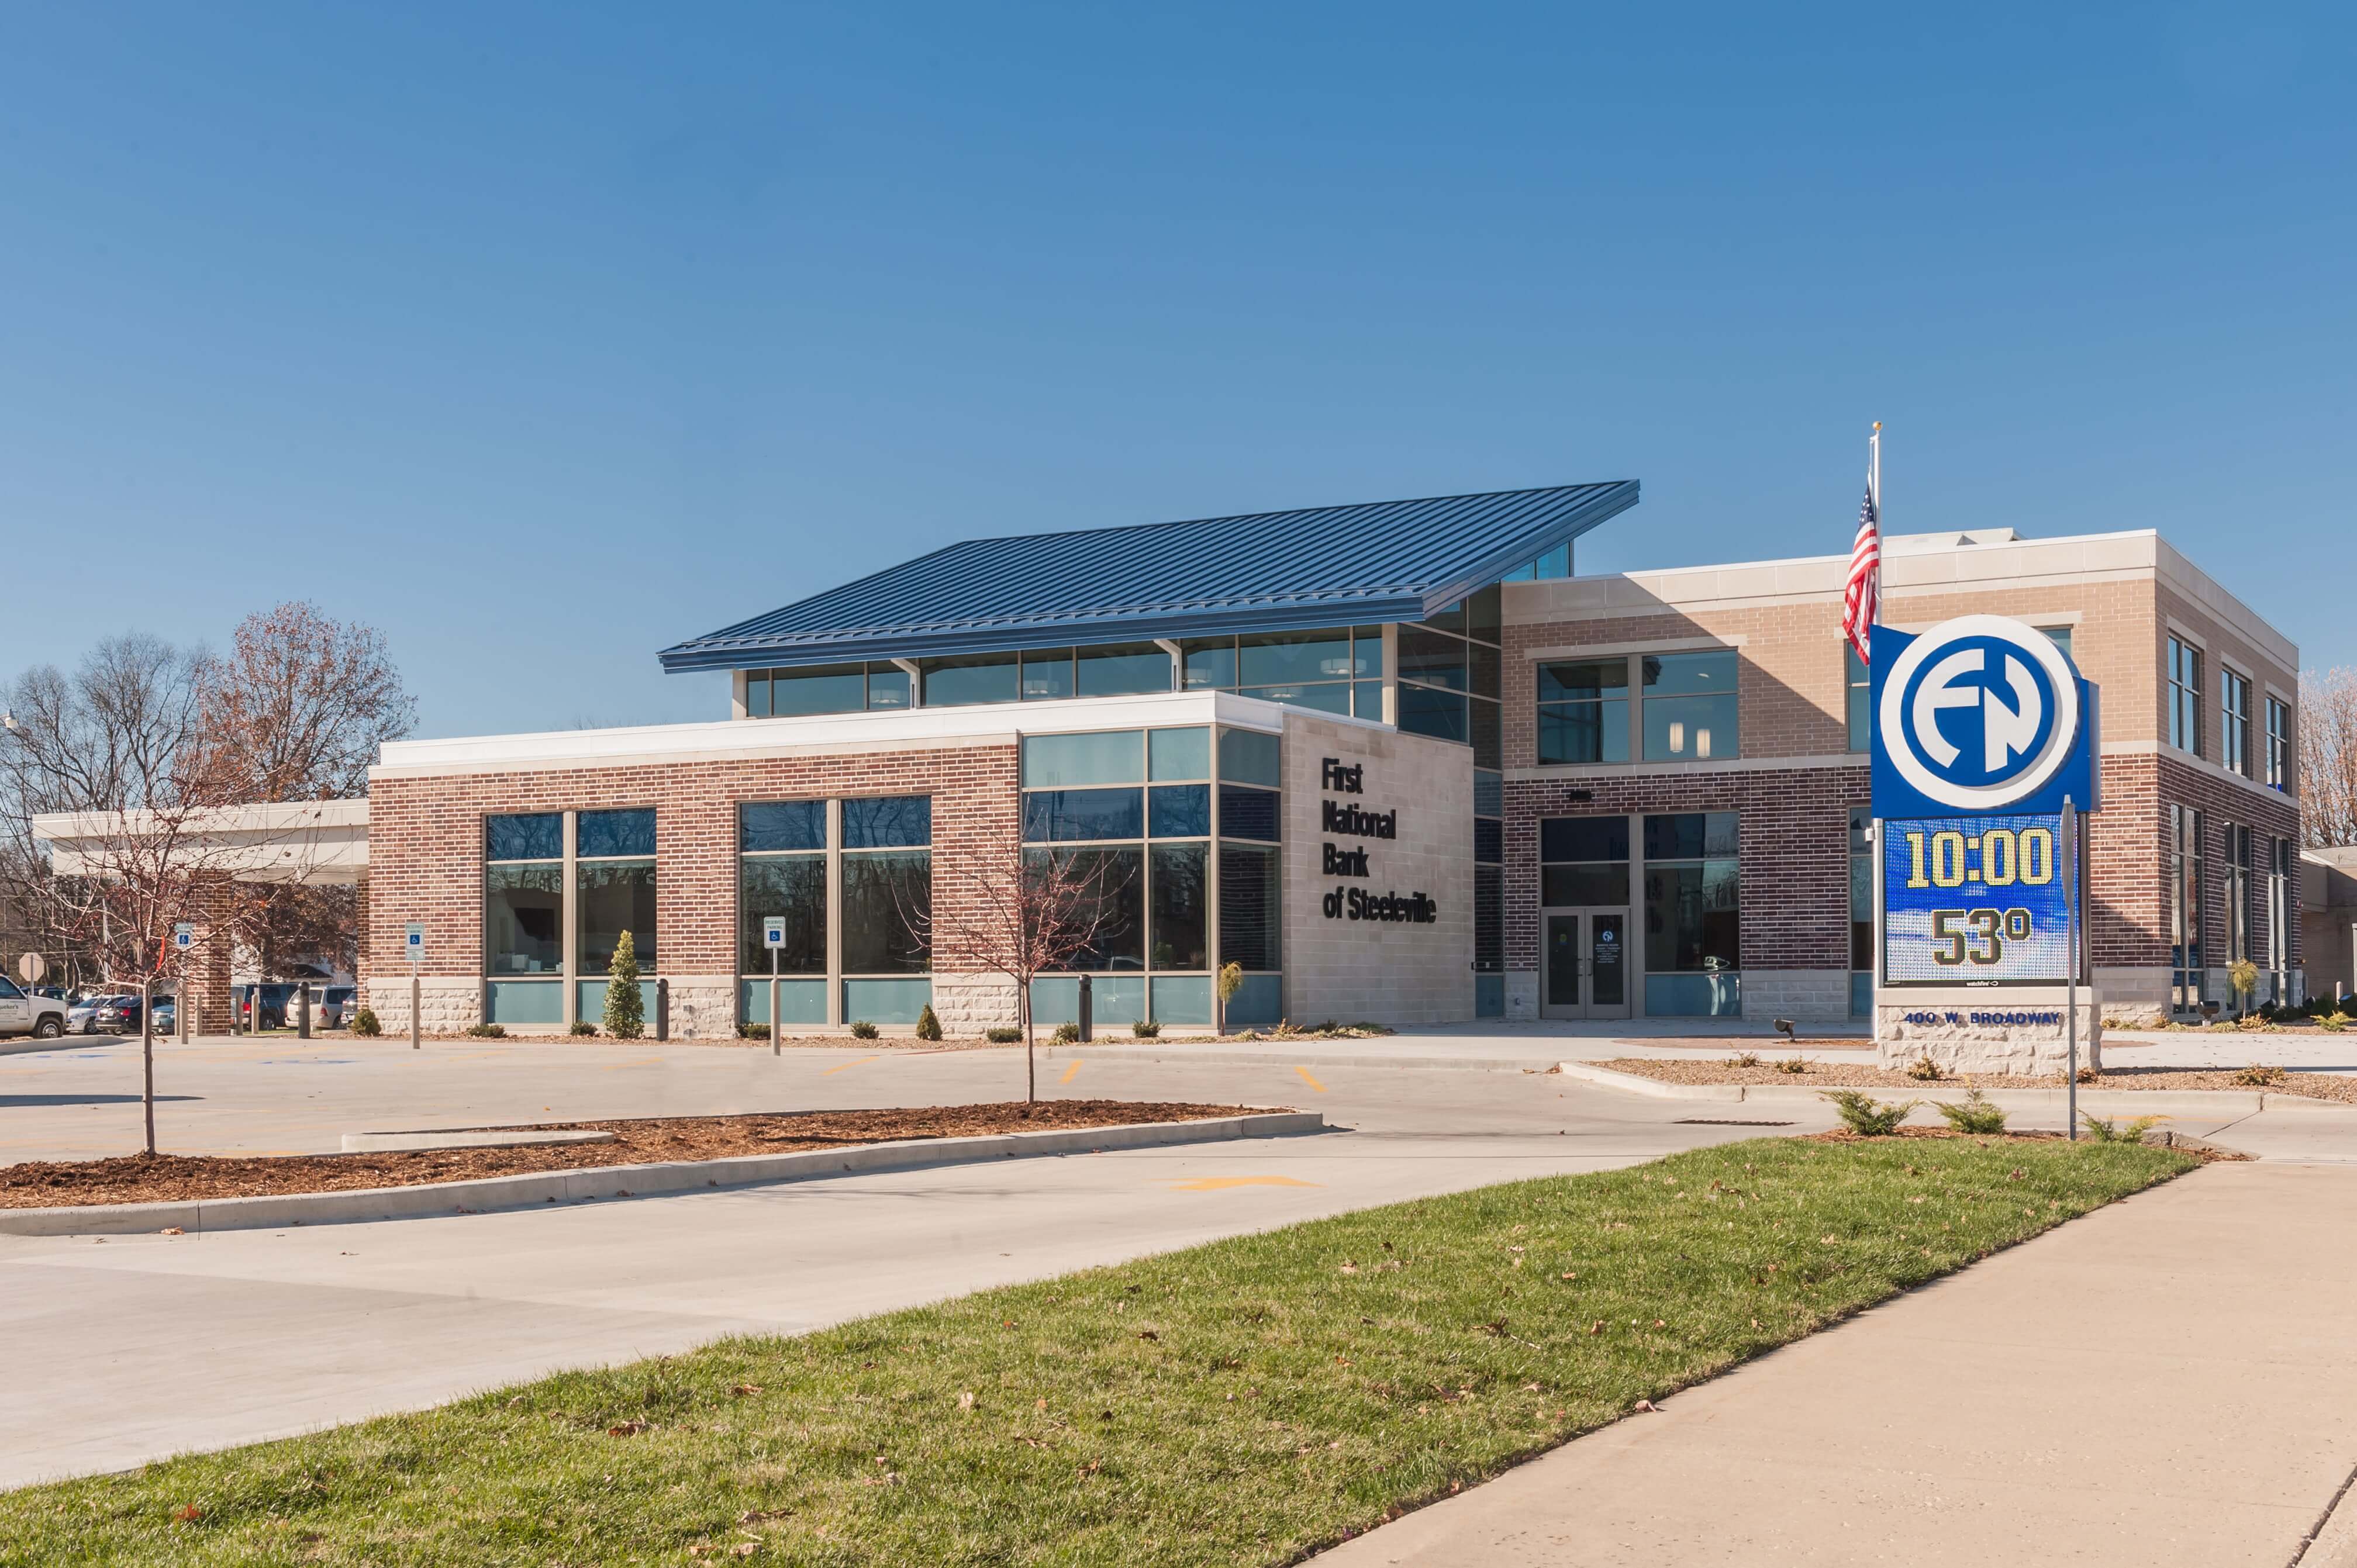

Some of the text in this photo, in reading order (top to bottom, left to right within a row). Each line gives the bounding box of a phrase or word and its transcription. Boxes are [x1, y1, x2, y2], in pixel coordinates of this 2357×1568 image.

[1323, 758, 1363, 793] First
[1323, 800, 1396, 839] National
[1323, 842, 1369, 877] Bank
[1906, 828, 2053, 888] 10:00
[1323, 886, 1436, 923] of Steeleville
[1904, 1012, 2059, 1024] 400 W. BROADWAY
